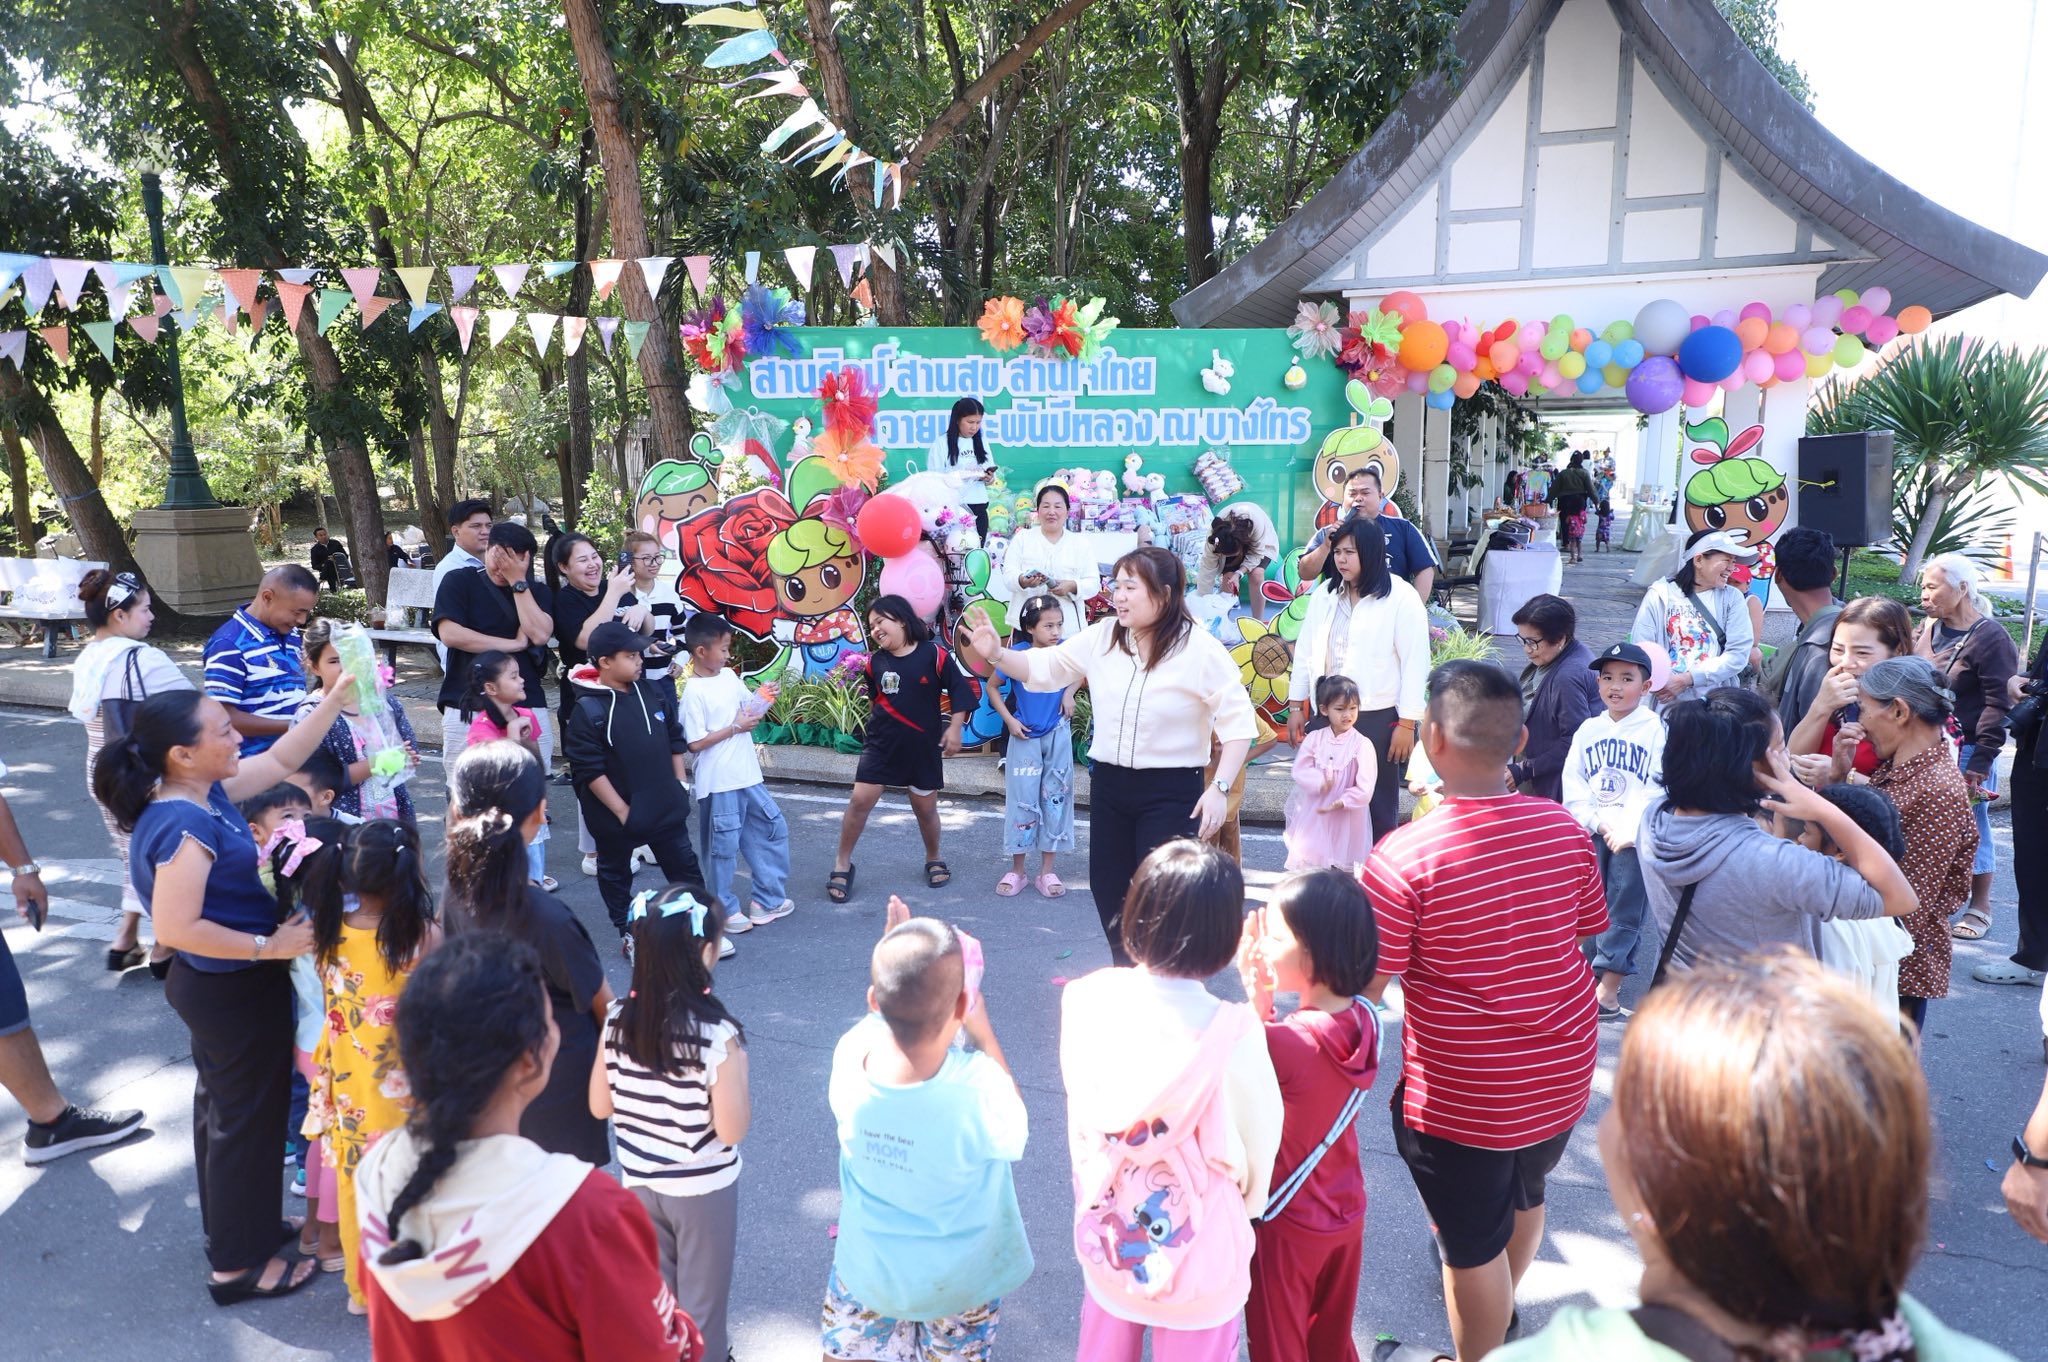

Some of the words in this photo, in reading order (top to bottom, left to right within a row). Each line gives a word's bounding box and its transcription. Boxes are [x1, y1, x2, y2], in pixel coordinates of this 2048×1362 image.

[1163, 412, 1196, 442] ณ
[1206, 400, 1308, 441] บางไทร
[1584, 738, 1650, 785] LIFORNI
[1600, 778, 1615, 792] LA
[884, 1132, 896, 1141] the
[897, 1136, 914, 1147] best
[866, 1141, 908, 1163] MOM
